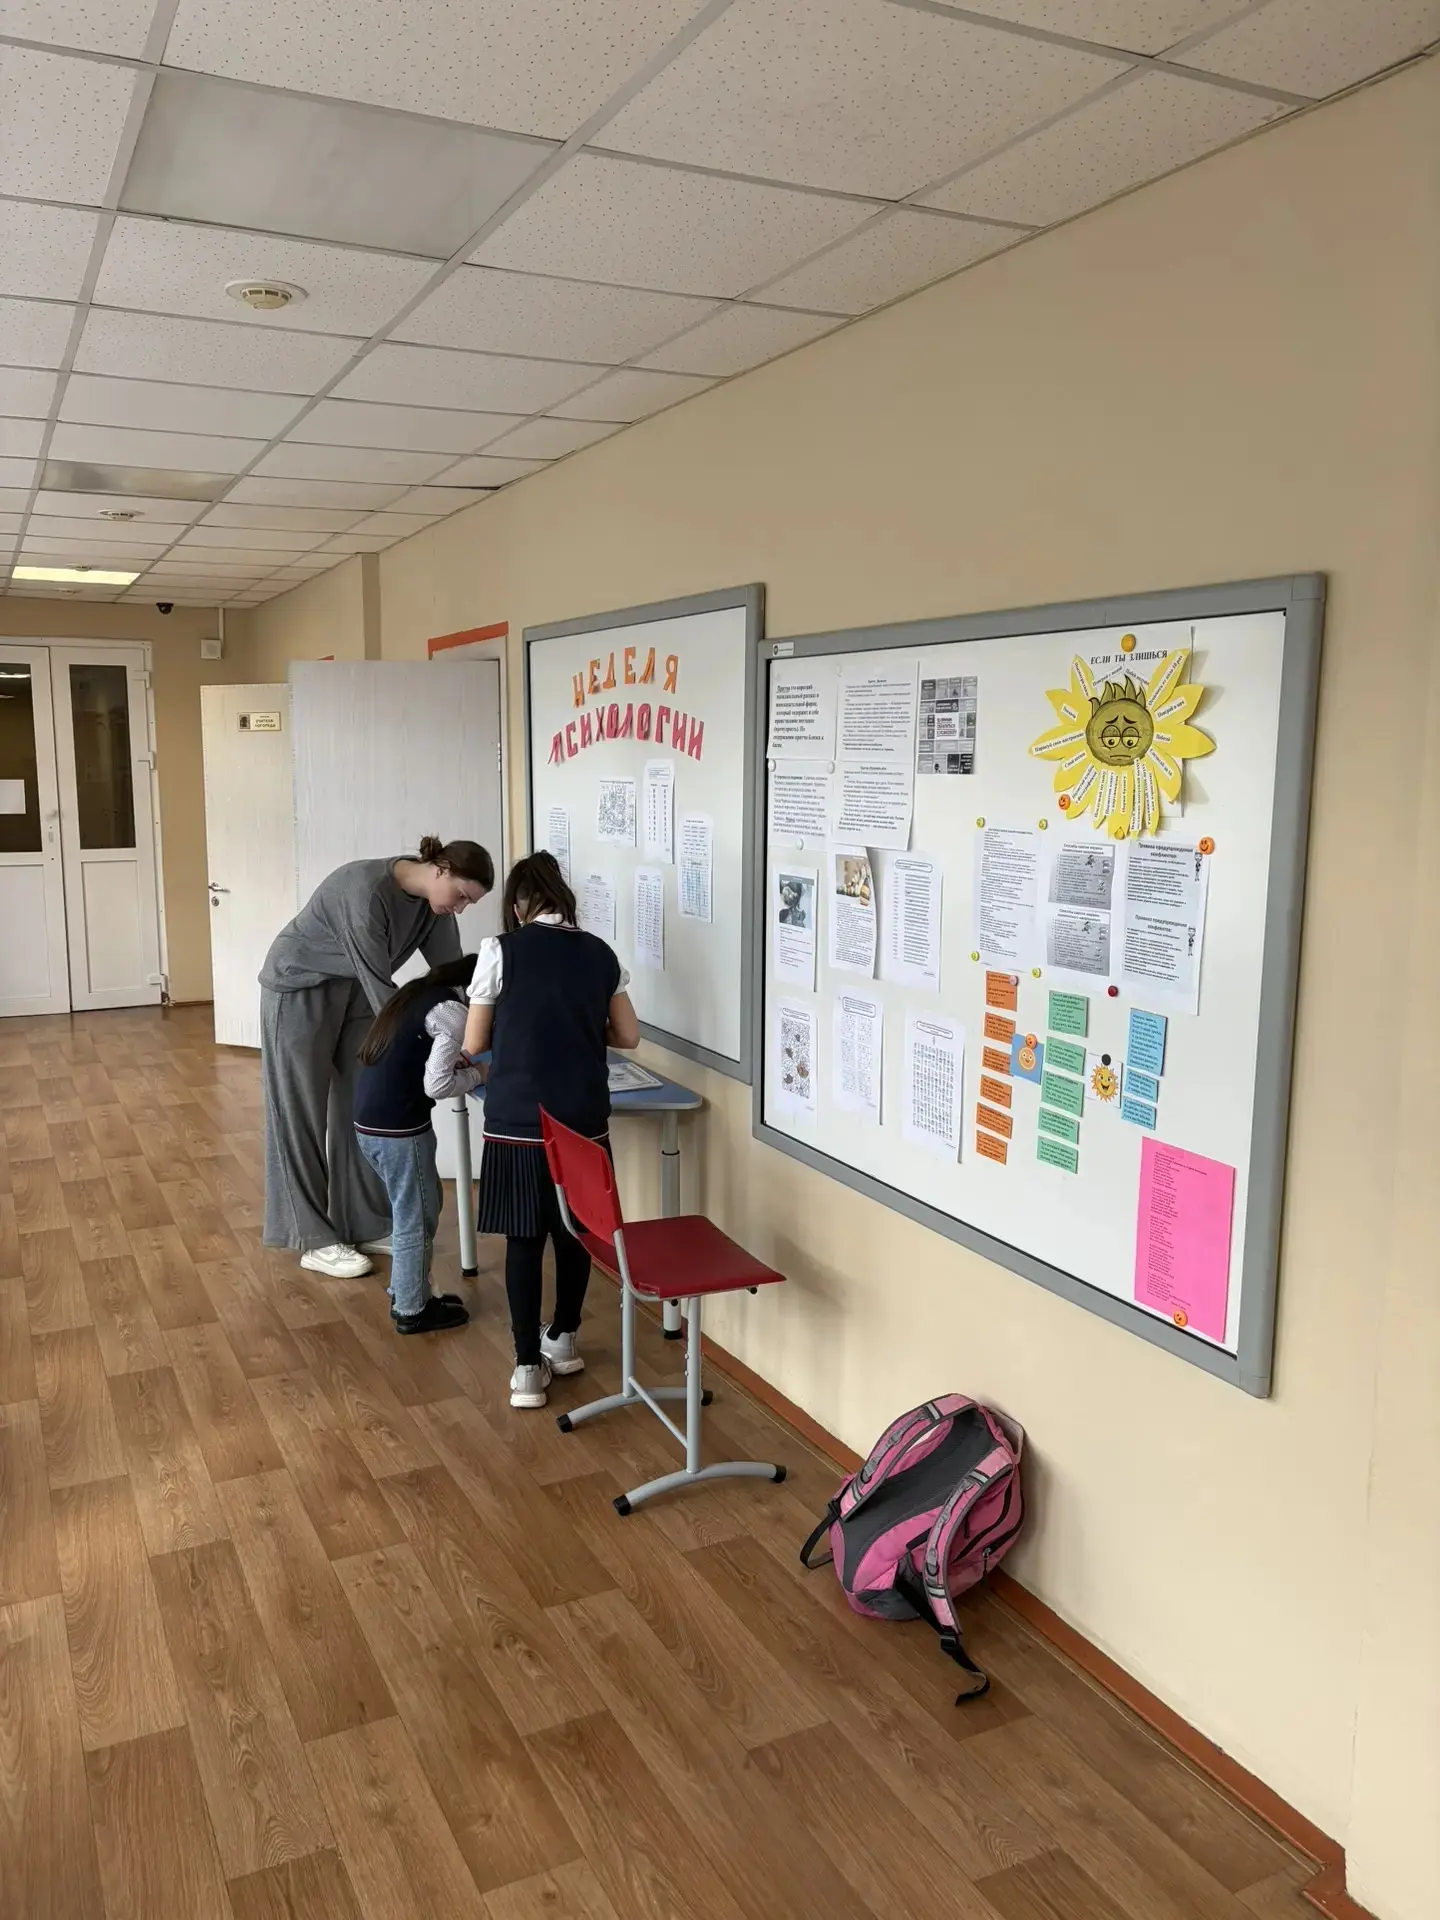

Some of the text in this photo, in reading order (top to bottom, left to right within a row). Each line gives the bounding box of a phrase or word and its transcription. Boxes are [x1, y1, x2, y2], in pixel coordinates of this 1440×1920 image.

[1090, 650, 1168, 664] ЕСЛИ ТЫ ЗЛИШЬСЯ
[572, 646, 679, 708] НЕДЕЛЯ
[1158, 705, 1174, 717] Поиграй
[1035, 743, 1052, 752] Нарисуй
[1062, 732, 1084, 743] настроение
[1064, 752, 1086, 768] Спой песню
[1135, 914, 1187, 928] Правила предупреждения
